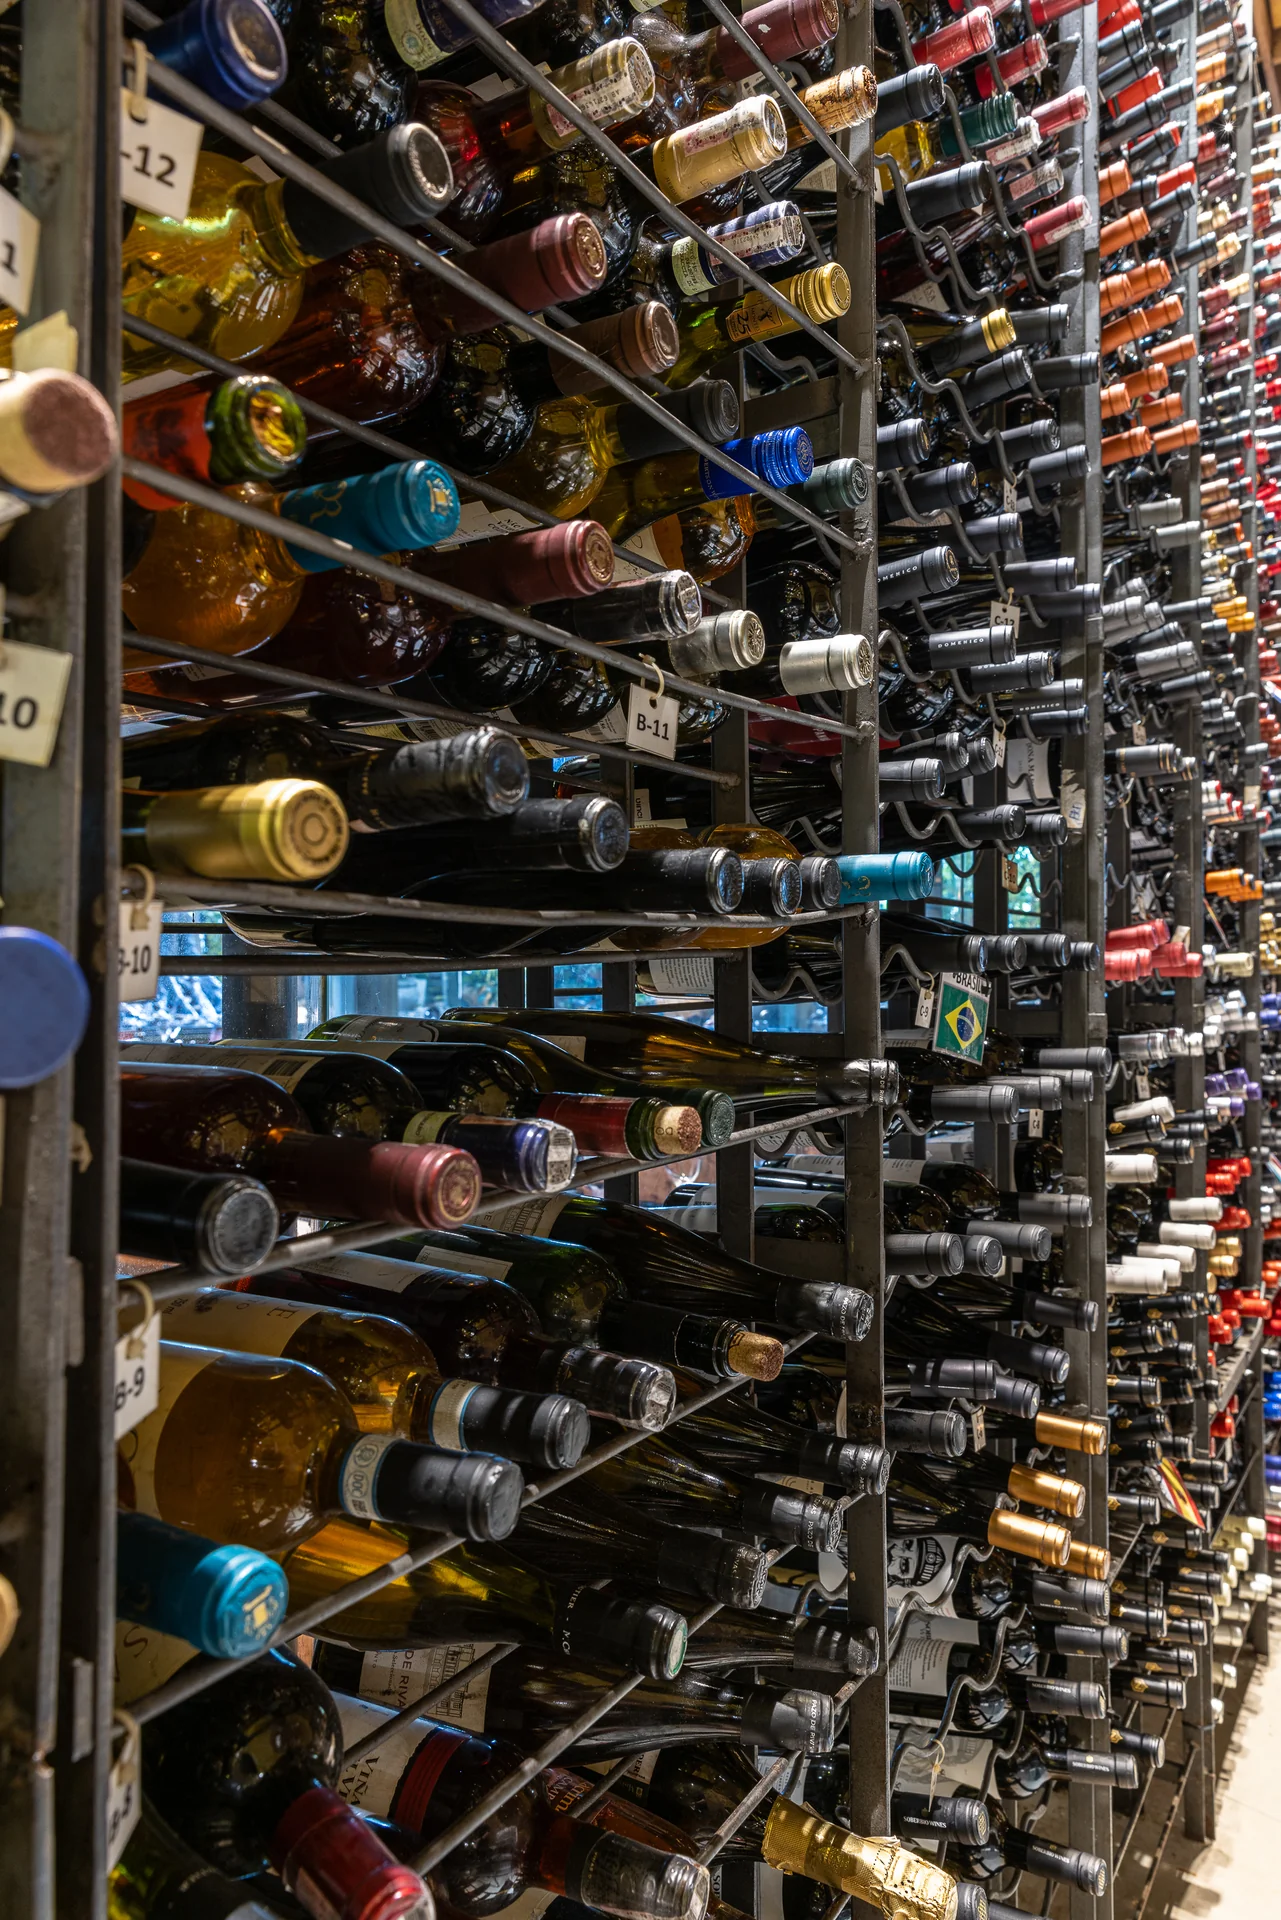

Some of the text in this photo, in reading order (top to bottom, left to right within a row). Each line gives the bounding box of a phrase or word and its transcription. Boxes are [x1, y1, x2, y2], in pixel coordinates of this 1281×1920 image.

[736, 312, 751, 335] 25
[937, 637, 985, 649] DOMENICO
[1019, 702, 1061, 712] DOMENICO
[636, 712, 670, 741] B-11
[919, 1005, 929, 1018] C-9
[351, 1474, 363, 1498] DOC
[810, 1699, 818, 1719] PAZO
